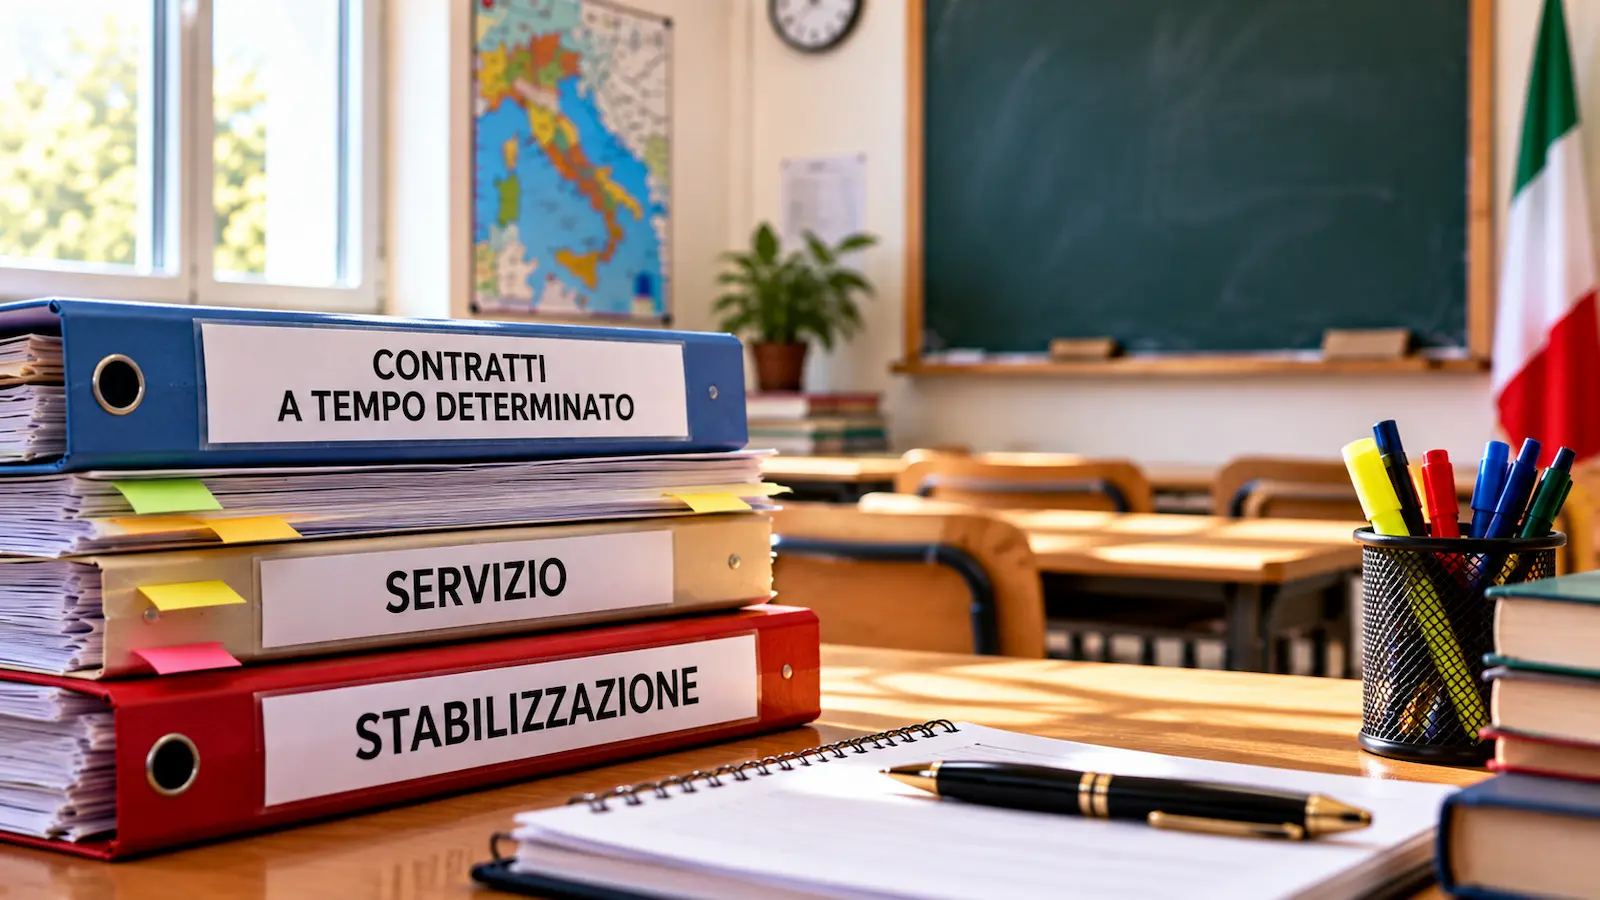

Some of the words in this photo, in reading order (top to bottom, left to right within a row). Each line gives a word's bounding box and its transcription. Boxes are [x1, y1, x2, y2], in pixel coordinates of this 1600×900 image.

[372, 348, 546, 383] CONTRATTI
[277, 389, 303, 422] A
[310, 390, 426, 422] TEMPO
[436, 391, 635, 422] DETERMINATO
[385, 557, 567, 614] SERVIZIO
[355, 665, 700, 761] STABILIZZAZIONE
